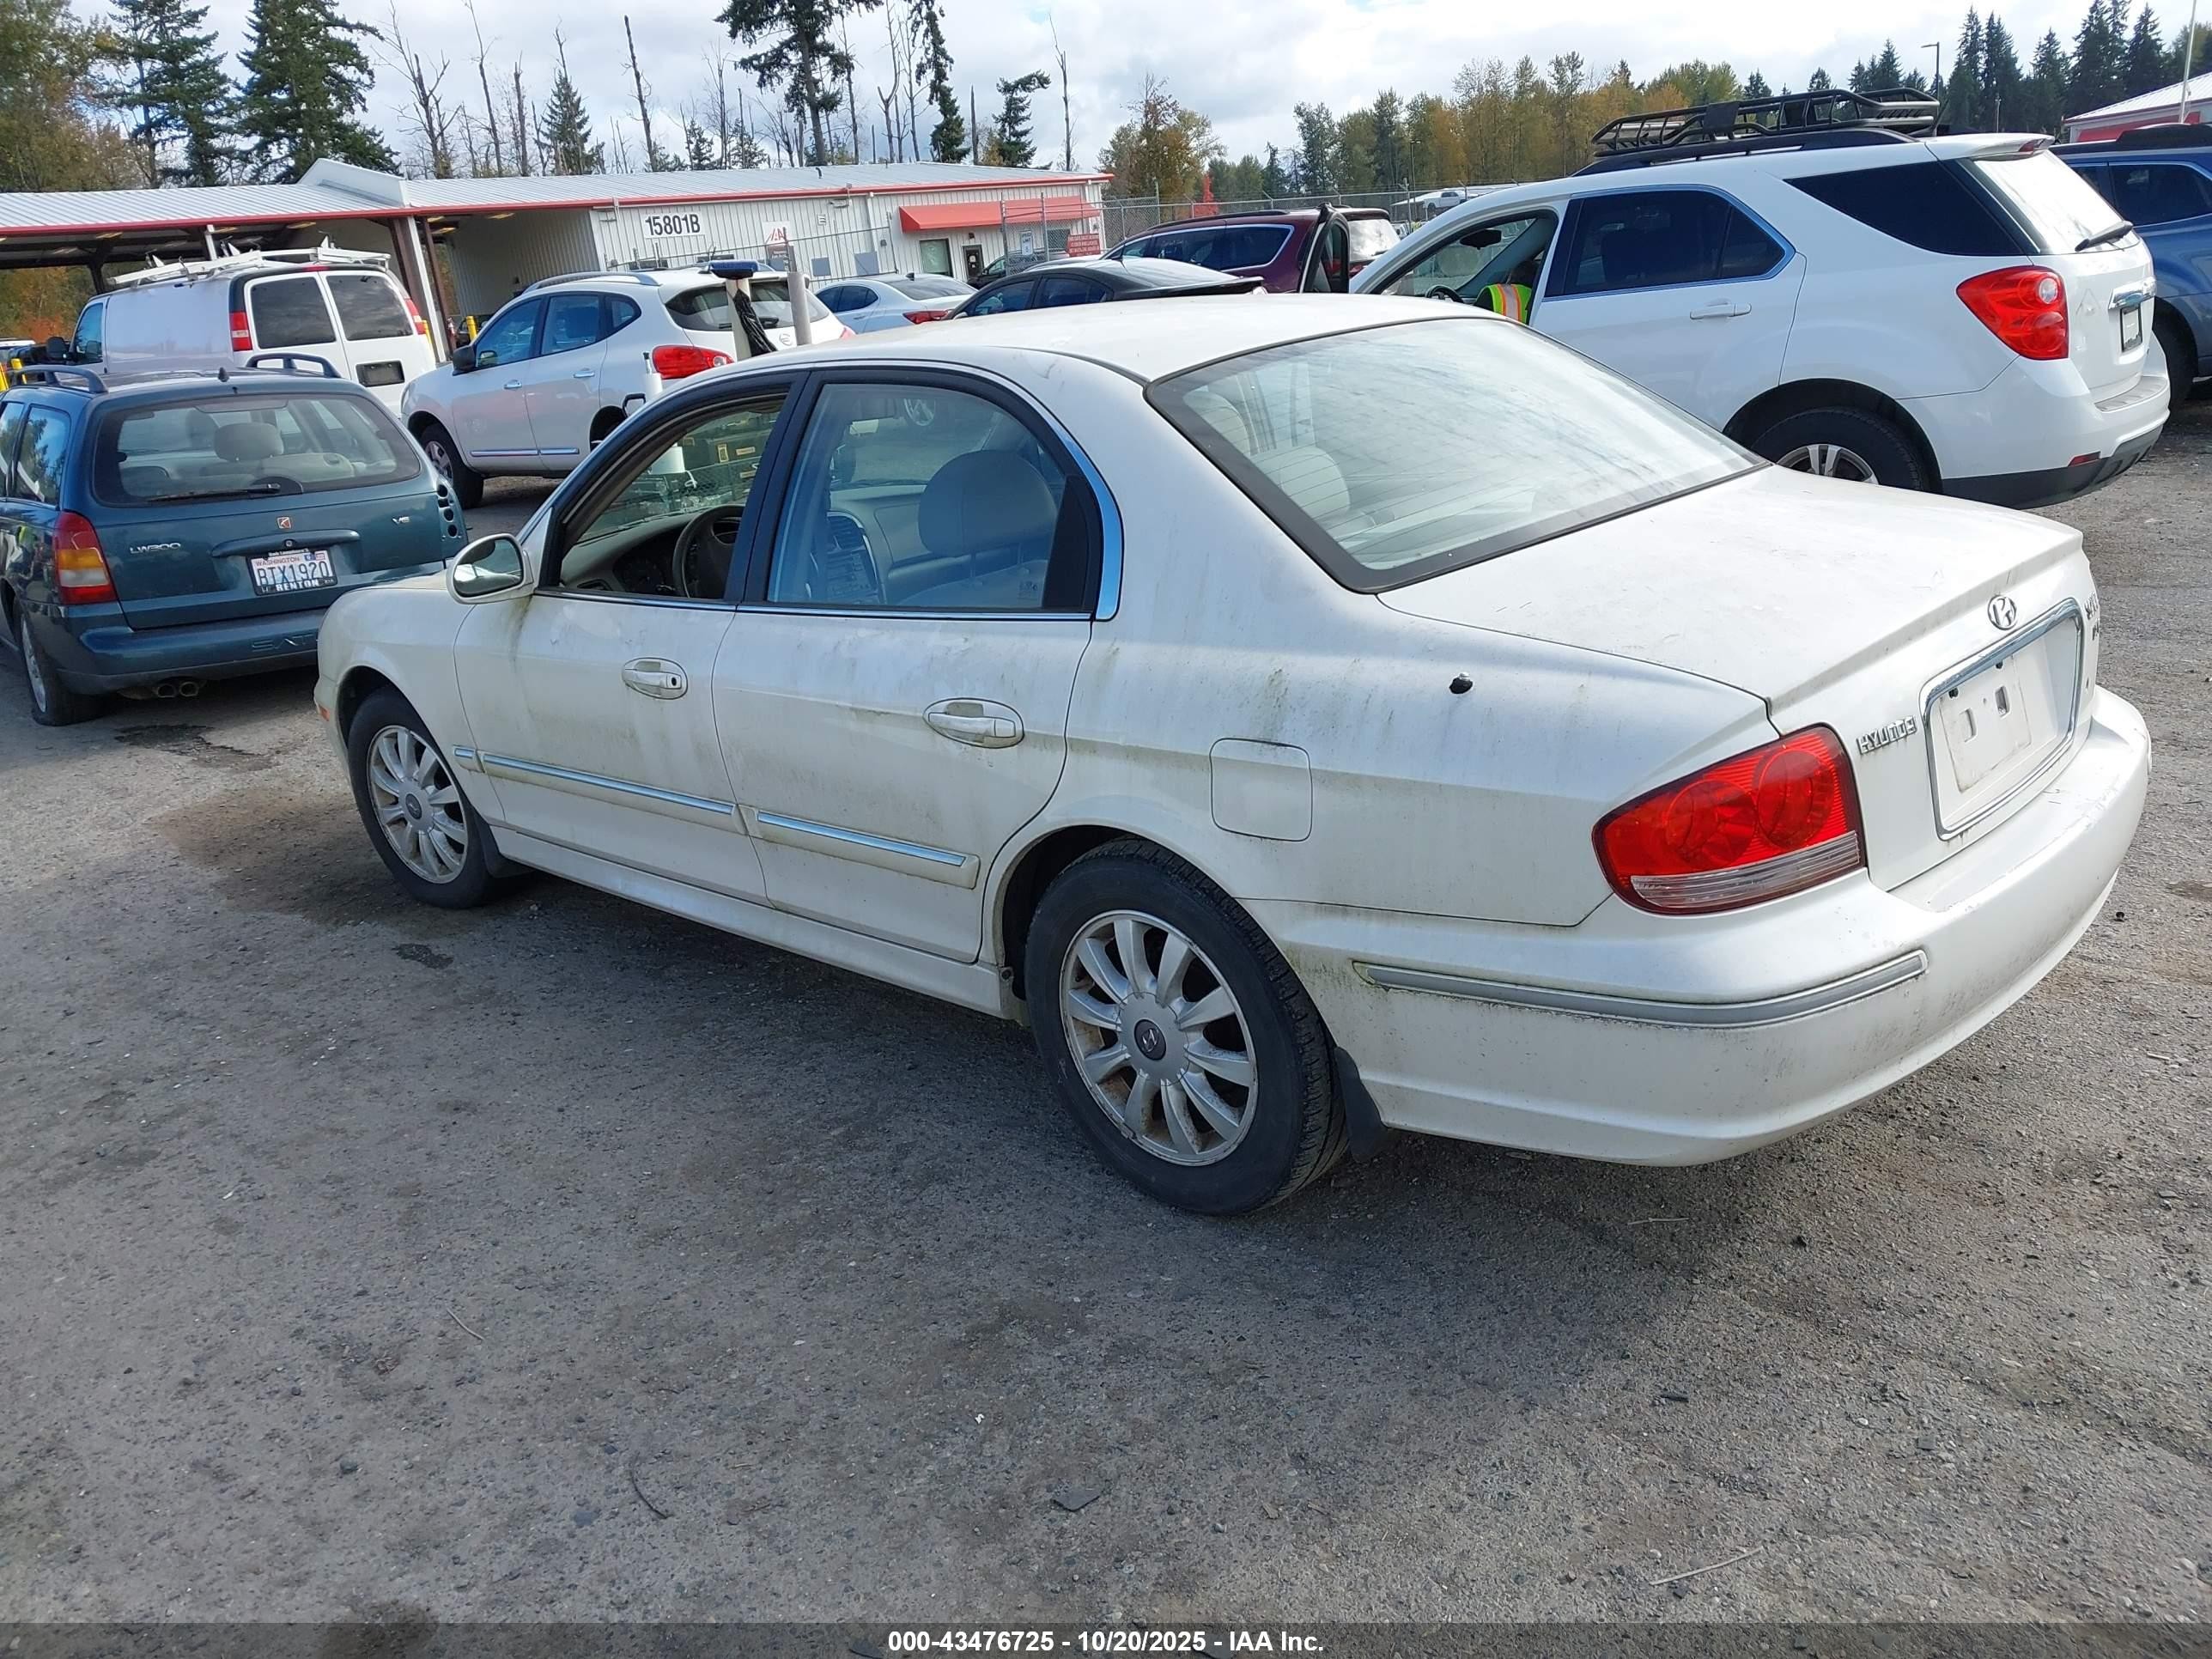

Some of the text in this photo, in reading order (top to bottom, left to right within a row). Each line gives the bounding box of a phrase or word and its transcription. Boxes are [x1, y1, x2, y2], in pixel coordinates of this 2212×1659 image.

[645, 214, 701, 236] 15801B
[130, 542, 181, 554] LW300
[255, 556, 301, 567] WASHINGTON
[276, 579, 319, 592] RENTON
